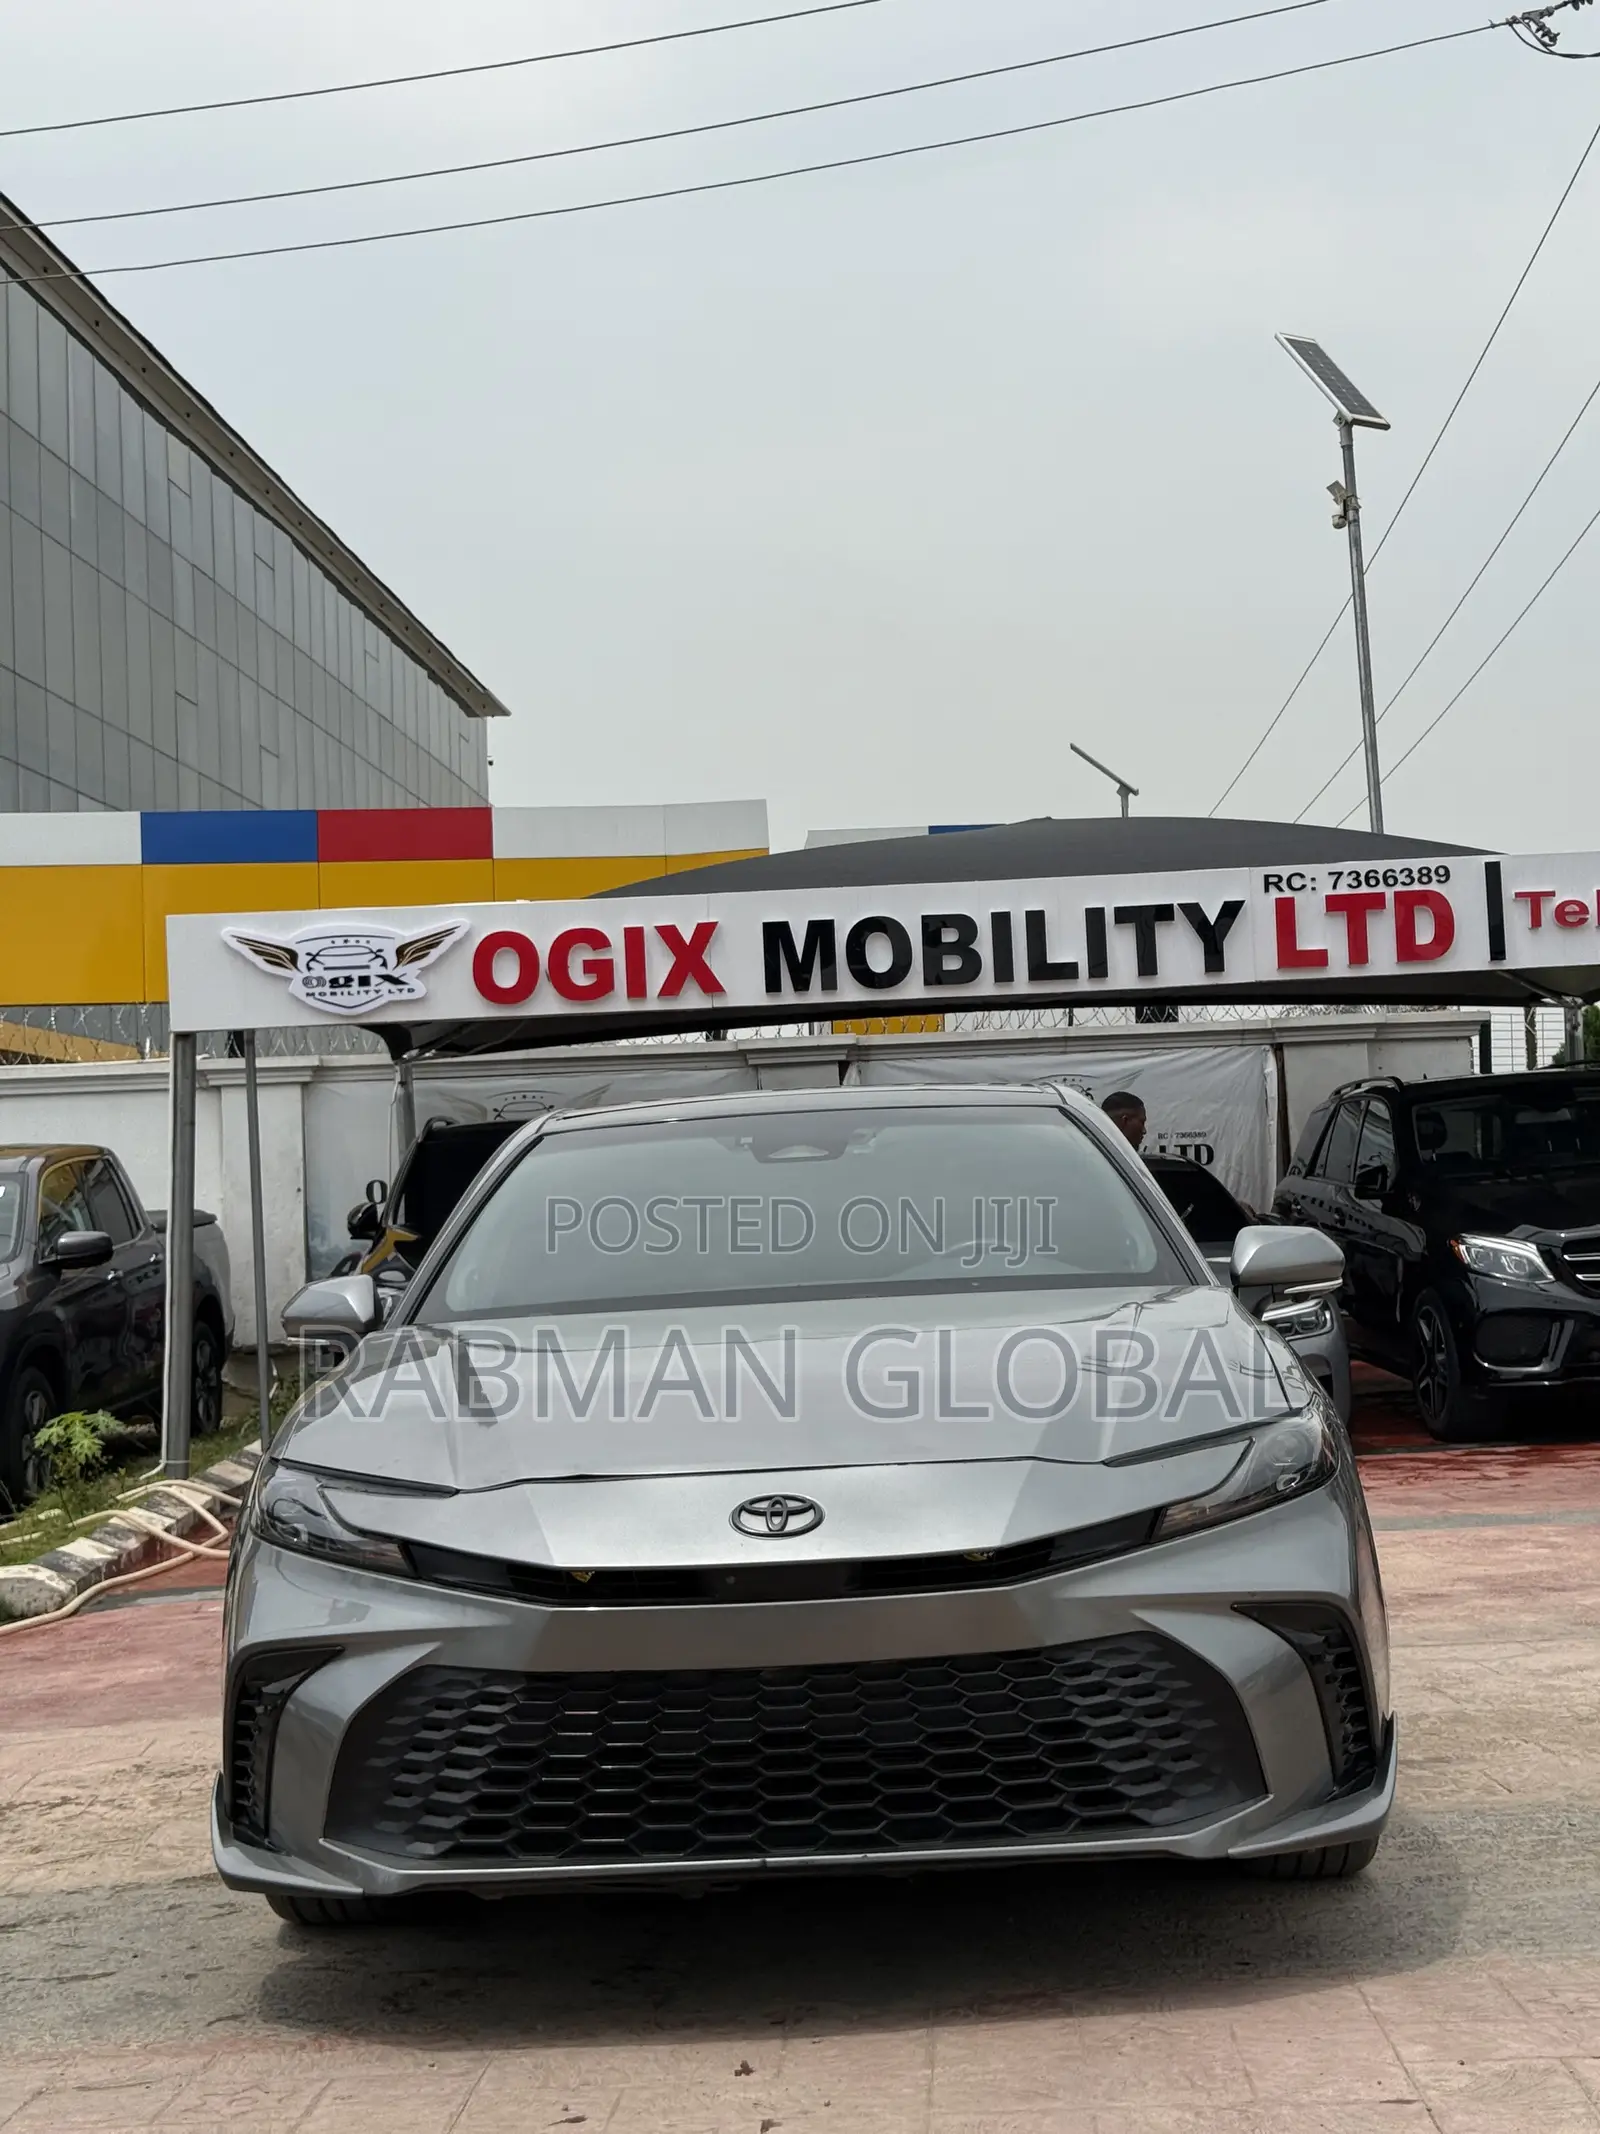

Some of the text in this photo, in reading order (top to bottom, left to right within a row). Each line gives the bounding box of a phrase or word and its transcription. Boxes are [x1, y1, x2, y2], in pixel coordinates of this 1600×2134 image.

[1264, 864, 1451, 893] RC: 7366389
[472, 889, 1456, 1004] OGIX MOBILITY LTD
[305, 988, 381, 997] MOBILITY
